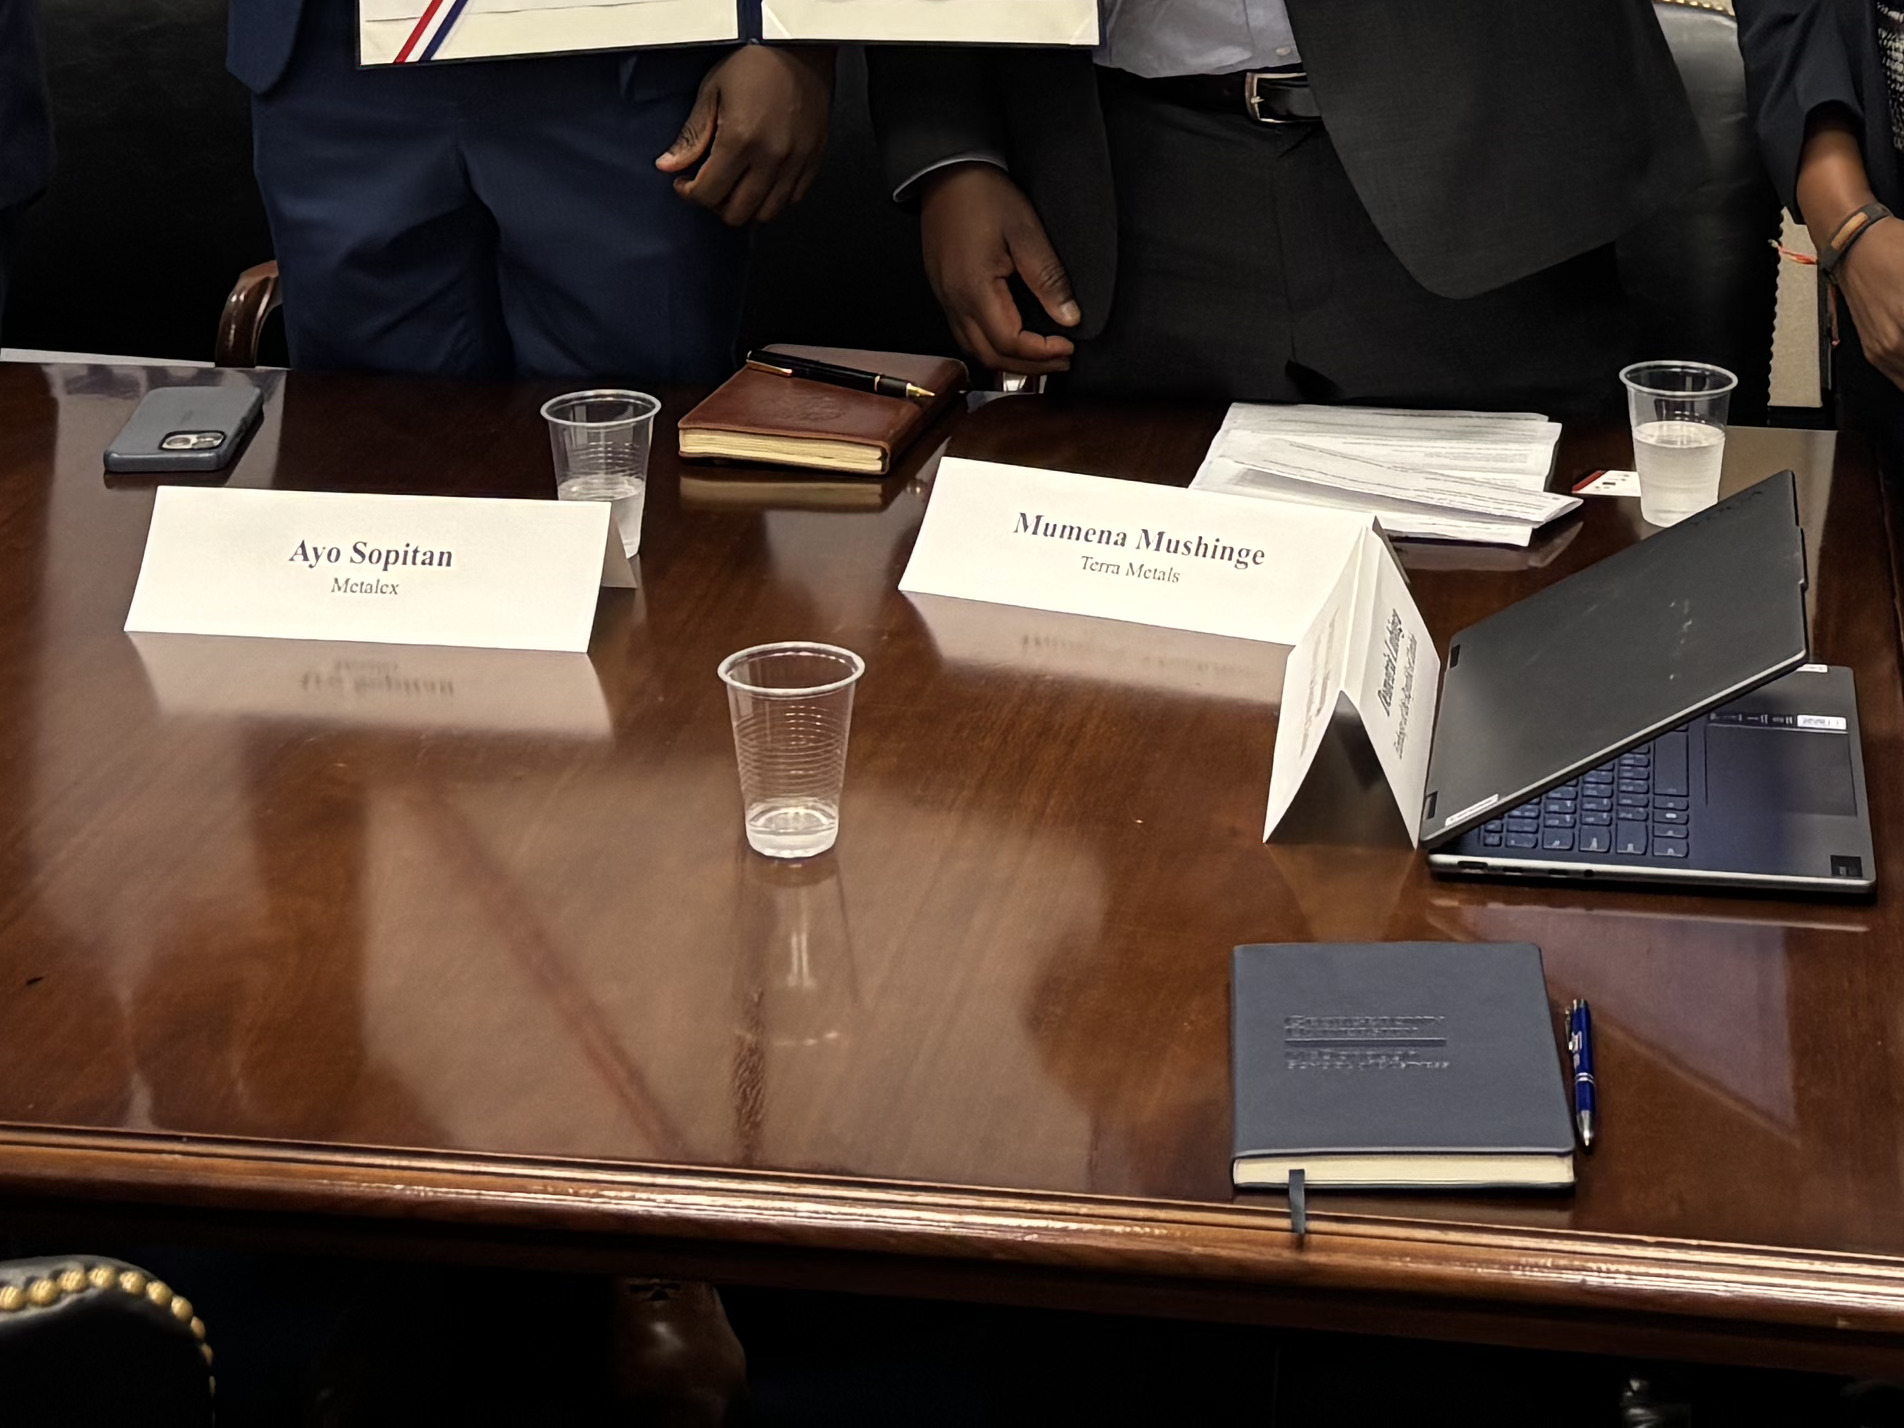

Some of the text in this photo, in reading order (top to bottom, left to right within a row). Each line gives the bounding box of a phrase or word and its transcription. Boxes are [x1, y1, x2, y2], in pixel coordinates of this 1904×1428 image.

[288, 539, 454, 572] Ayo Sopitan
[1012, 511, 1266, 572] Mumena Mushinge
[330, 576, 400, 596] Metalex
[1080, 555, 1181, 586] Terra Metals
